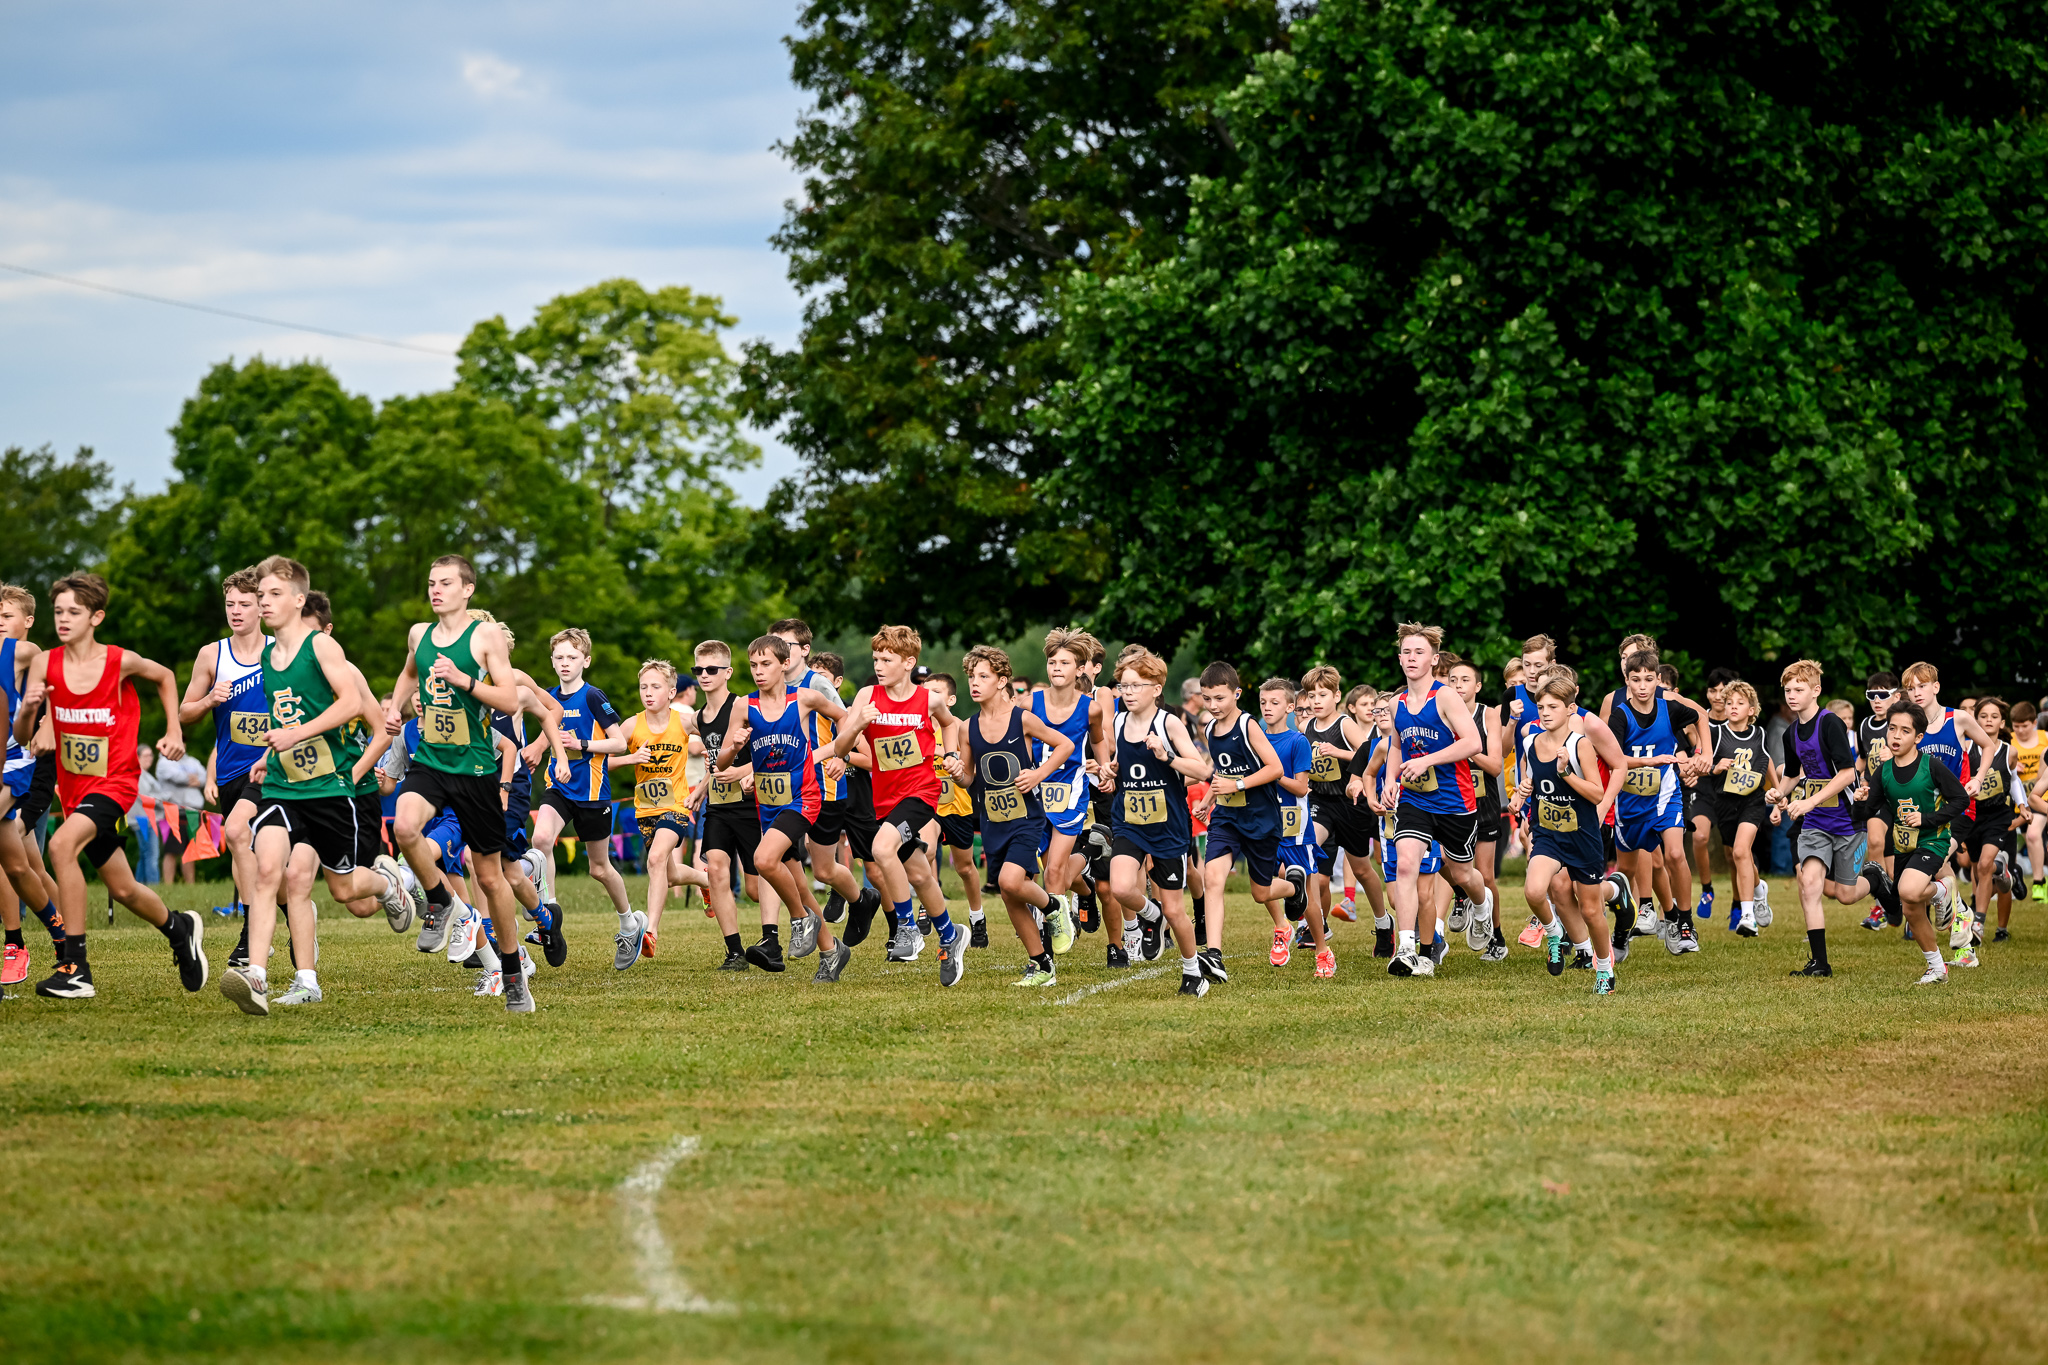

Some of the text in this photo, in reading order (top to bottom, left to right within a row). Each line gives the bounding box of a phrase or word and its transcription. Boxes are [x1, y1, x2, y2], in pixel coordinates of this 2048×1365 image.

[228, 672, 264, 700] SAINT
[54, 706, 110, 724] FRANKTON
[236, 717, 269, 734] 434
[435, 714, 456, 733] 55
[1420, 727, 1438, 740] WELLS
[64, 740, 99, 762] 139
[636, 743, 682, 753] RFIELD
[752, 734, 800, 752] SOUTHERN WELLS
[882, 739, 914, 759] 142
[1921, 744, 1957, 757] THERN WELLS
[293, 746, 318, 768] 59
[1870, 756, 1880, 770] 35
[1230, 764, 1250, 774] HILL
[759, 778, 784, 794] 410
[1141, 779, 1167, 788] HILL
[1627, 772, 1653, 786] 211
[1730, 771, 1756, 788] 345
[640, 782, 668, 798] 103
[1042, 787, 1064, 802] 90
[1809, 783, 1823, 798] 27
[989, 793, 1018, 812] 305
[1129, 796, 1157, 813] 311
[1543, 806, 1571, 823] 304
[1898, 831, 1910, 846] 58
